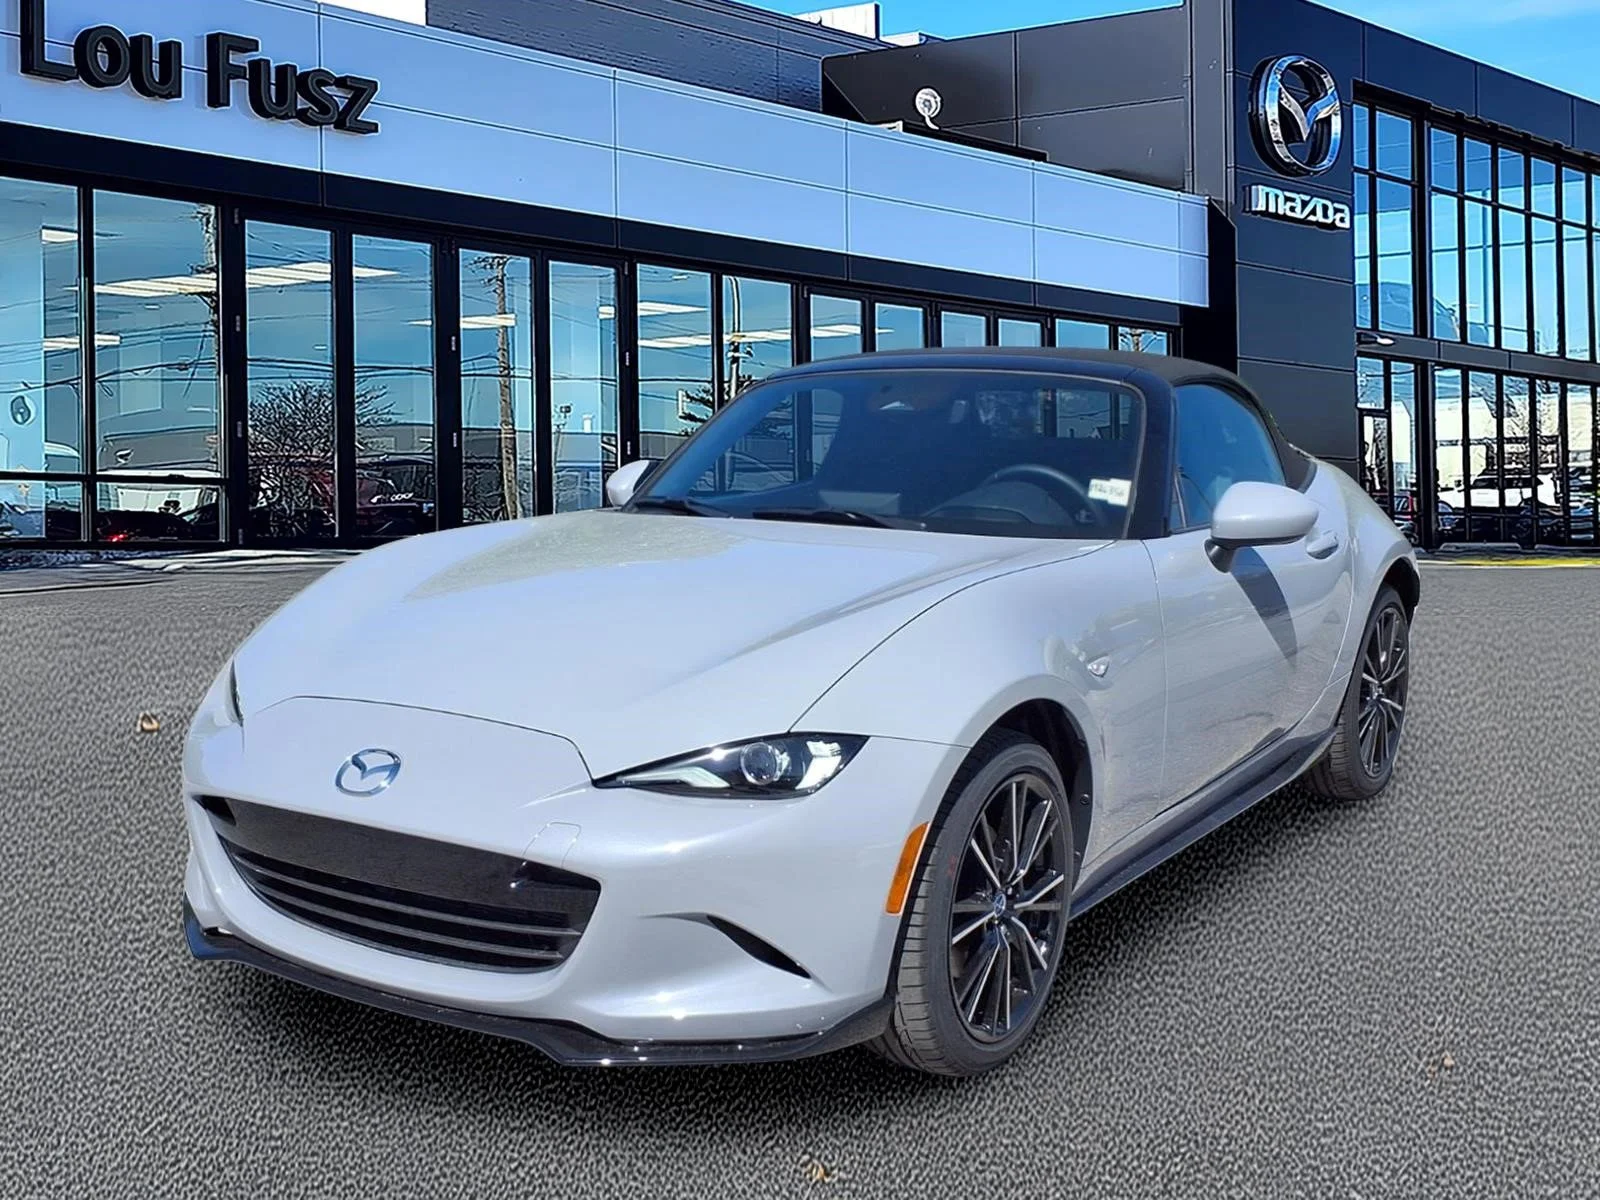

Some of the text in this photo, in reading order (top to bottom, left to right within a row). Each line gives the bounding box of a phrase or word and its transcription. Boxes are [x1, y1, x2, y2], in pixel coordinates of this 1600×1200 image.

[20, 0, 379, 134] Lou Fusz
[1250, 185, 1350, 229] mazda
